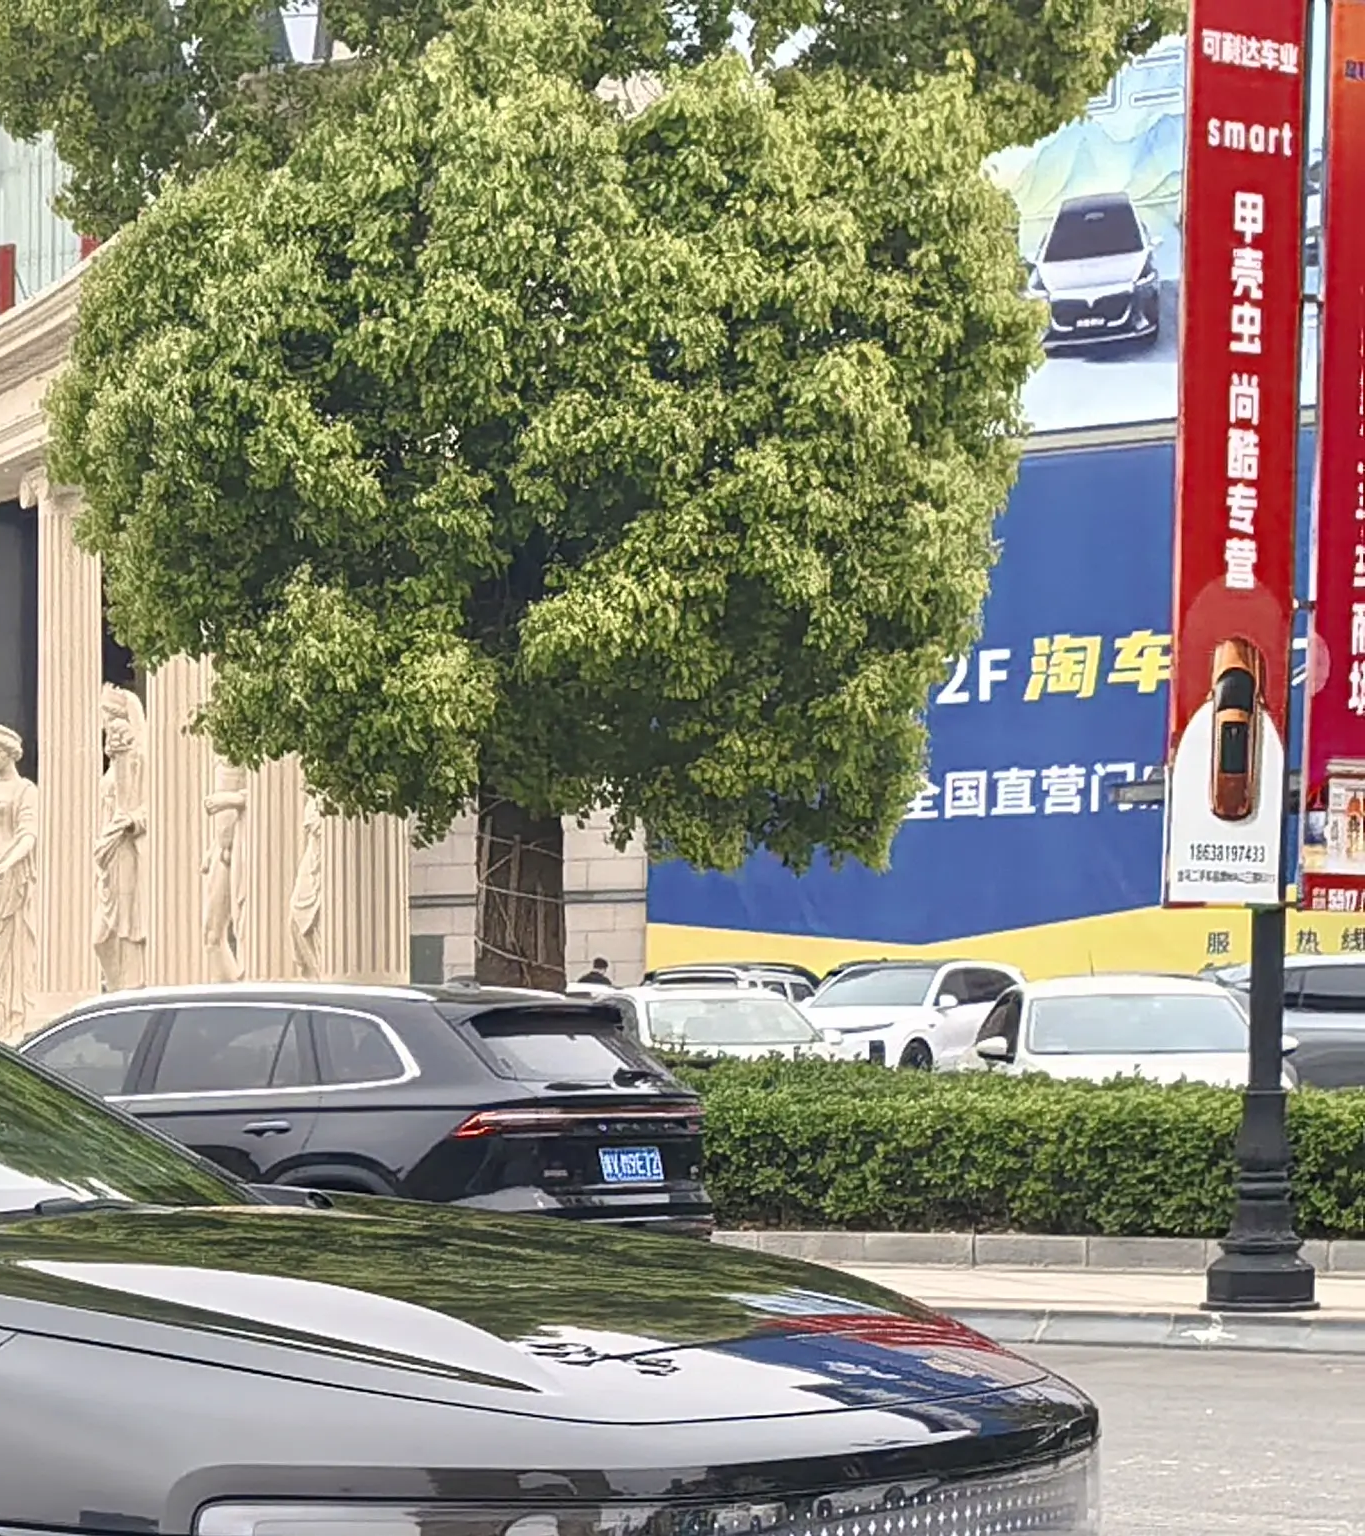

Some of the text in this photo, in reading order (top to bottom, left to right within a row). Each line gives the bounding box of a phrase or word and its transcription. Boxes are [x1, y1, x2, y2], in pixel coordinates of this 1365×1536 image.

[1201, 28, 1299, 74] 可利达车业
[1208, 117, 1293, 157] smart
[1229, 191, 1265, 355] 甲壳虫
[936, 648, 1012, 706] 2F
[902, 761, 1166, 820] 全国直营门
